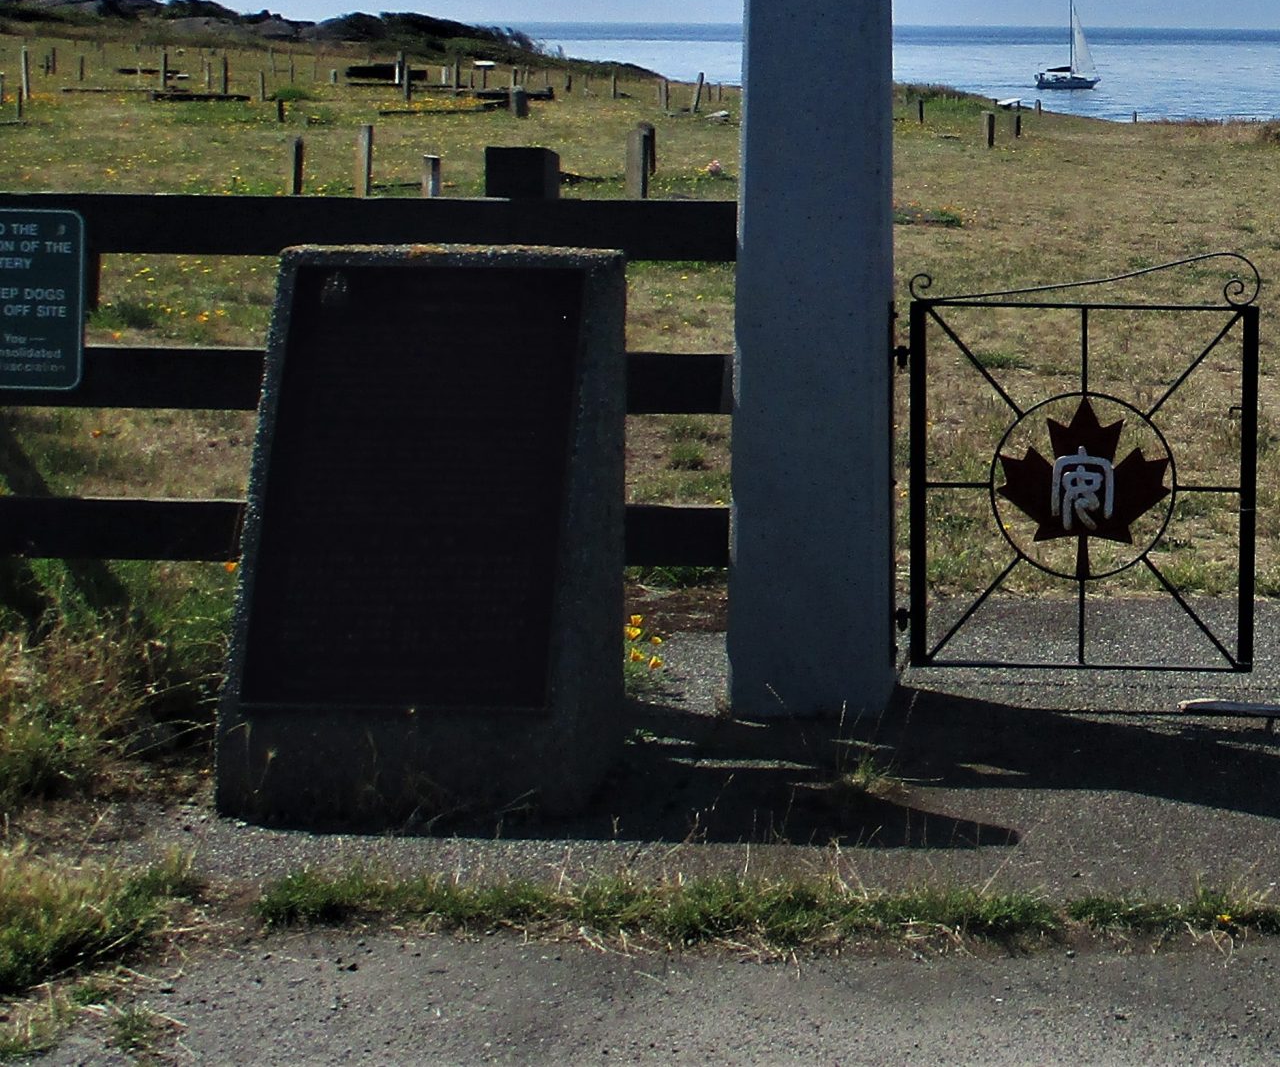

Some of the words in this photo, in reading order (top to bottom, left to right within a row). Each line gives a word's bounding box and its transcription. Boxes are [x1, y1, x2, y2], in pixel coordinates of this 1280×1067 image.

[10, 223, 39, 236] THE
[20, 240, 41, 253] OF
[44, 241, 72, 254] THE
[0, 287, 19, 300] EP
[24, 288, 65, 301] DOGS
[3, 304, 31, 316] OFF
[36, 305, 67, 318] SITE
[3, 333, 27, 344] You
